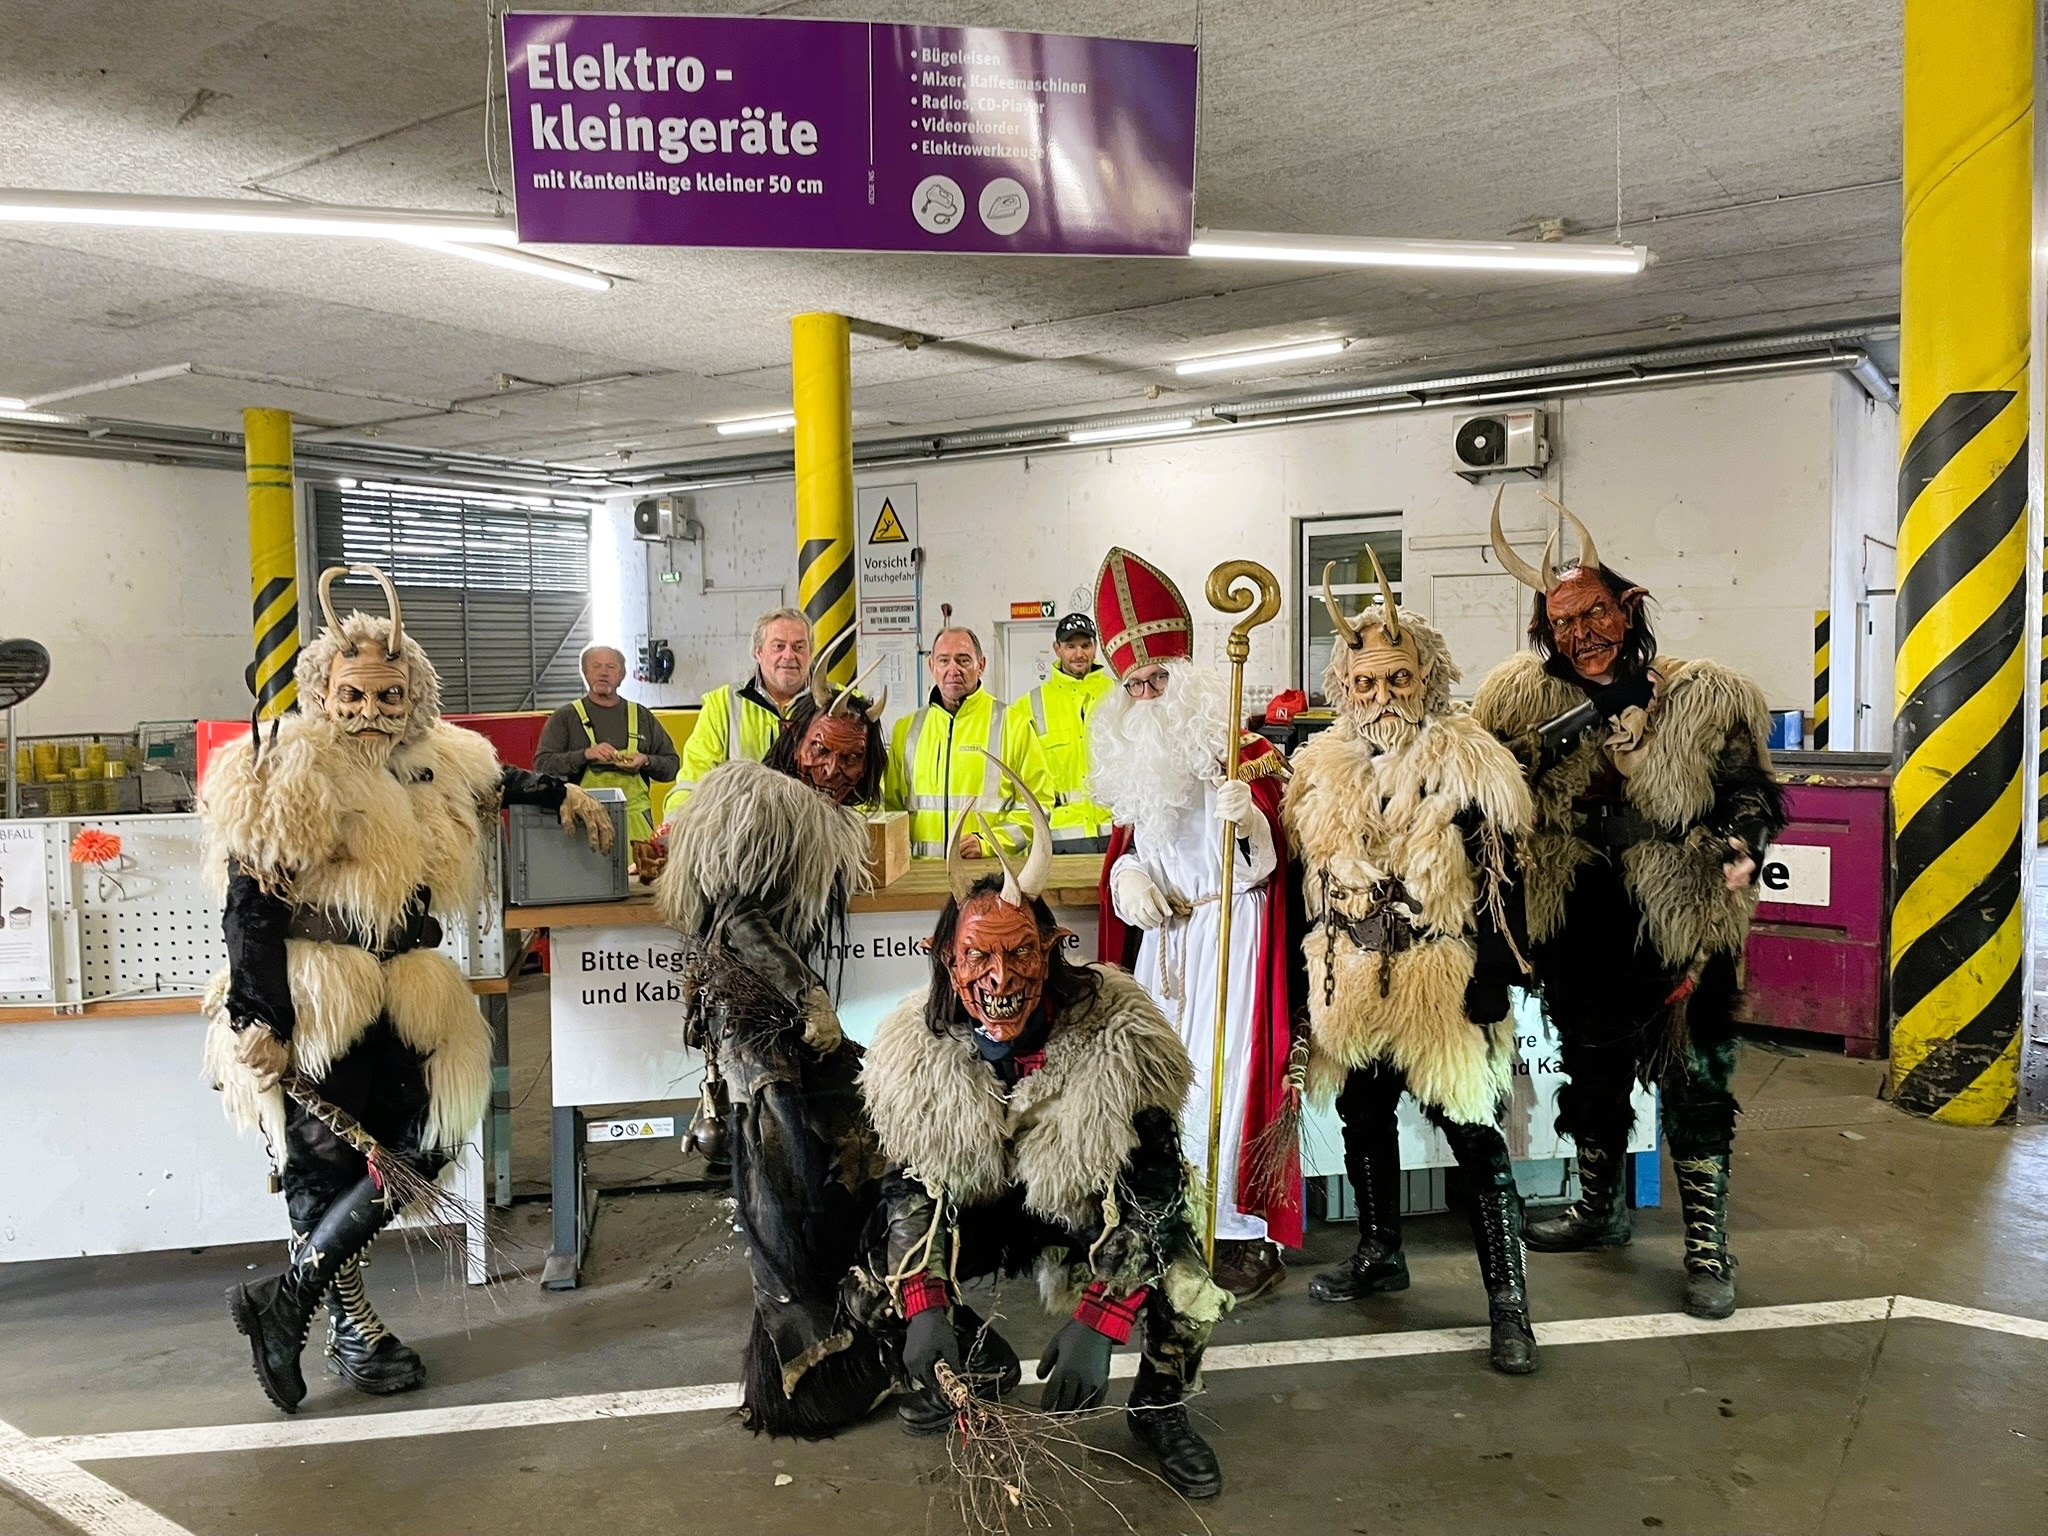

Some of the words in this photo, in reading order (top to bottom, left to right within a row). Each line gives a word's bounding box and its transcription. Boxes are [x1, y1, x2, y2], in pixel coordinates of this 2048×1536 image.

[922, 47, 1000, 67] Bügeleisen
[922, 70, 967, 89] Mixer,
[970, 74, 1087, 94] Kaffeemaschinen
[922, 94, 974, 113] Radios,
[978, 97, 1045, 116] CD-Player
[530, 103, 818, 164] kleingeräte
[922, 117, 1020, 135] Videorekorder
[922, 139, 1045, 161] Elektrowerkzeuge
[533, 169, 565, 190] mit
[569, 170, 691, 195] Kantenlänge
[696, 172, 764, 192] kleiner
[769, 175, 791, 193] 50
[796, 177, 823, 194] cm
[864, 555, 908, 569] Vorsicht
[864, 571, 916, 584] Rutschgefahr
[582, 950, 639, 972] Bitte
[821, 938, 865, 960] Ihre
[582, 982, 627, 1005] und
